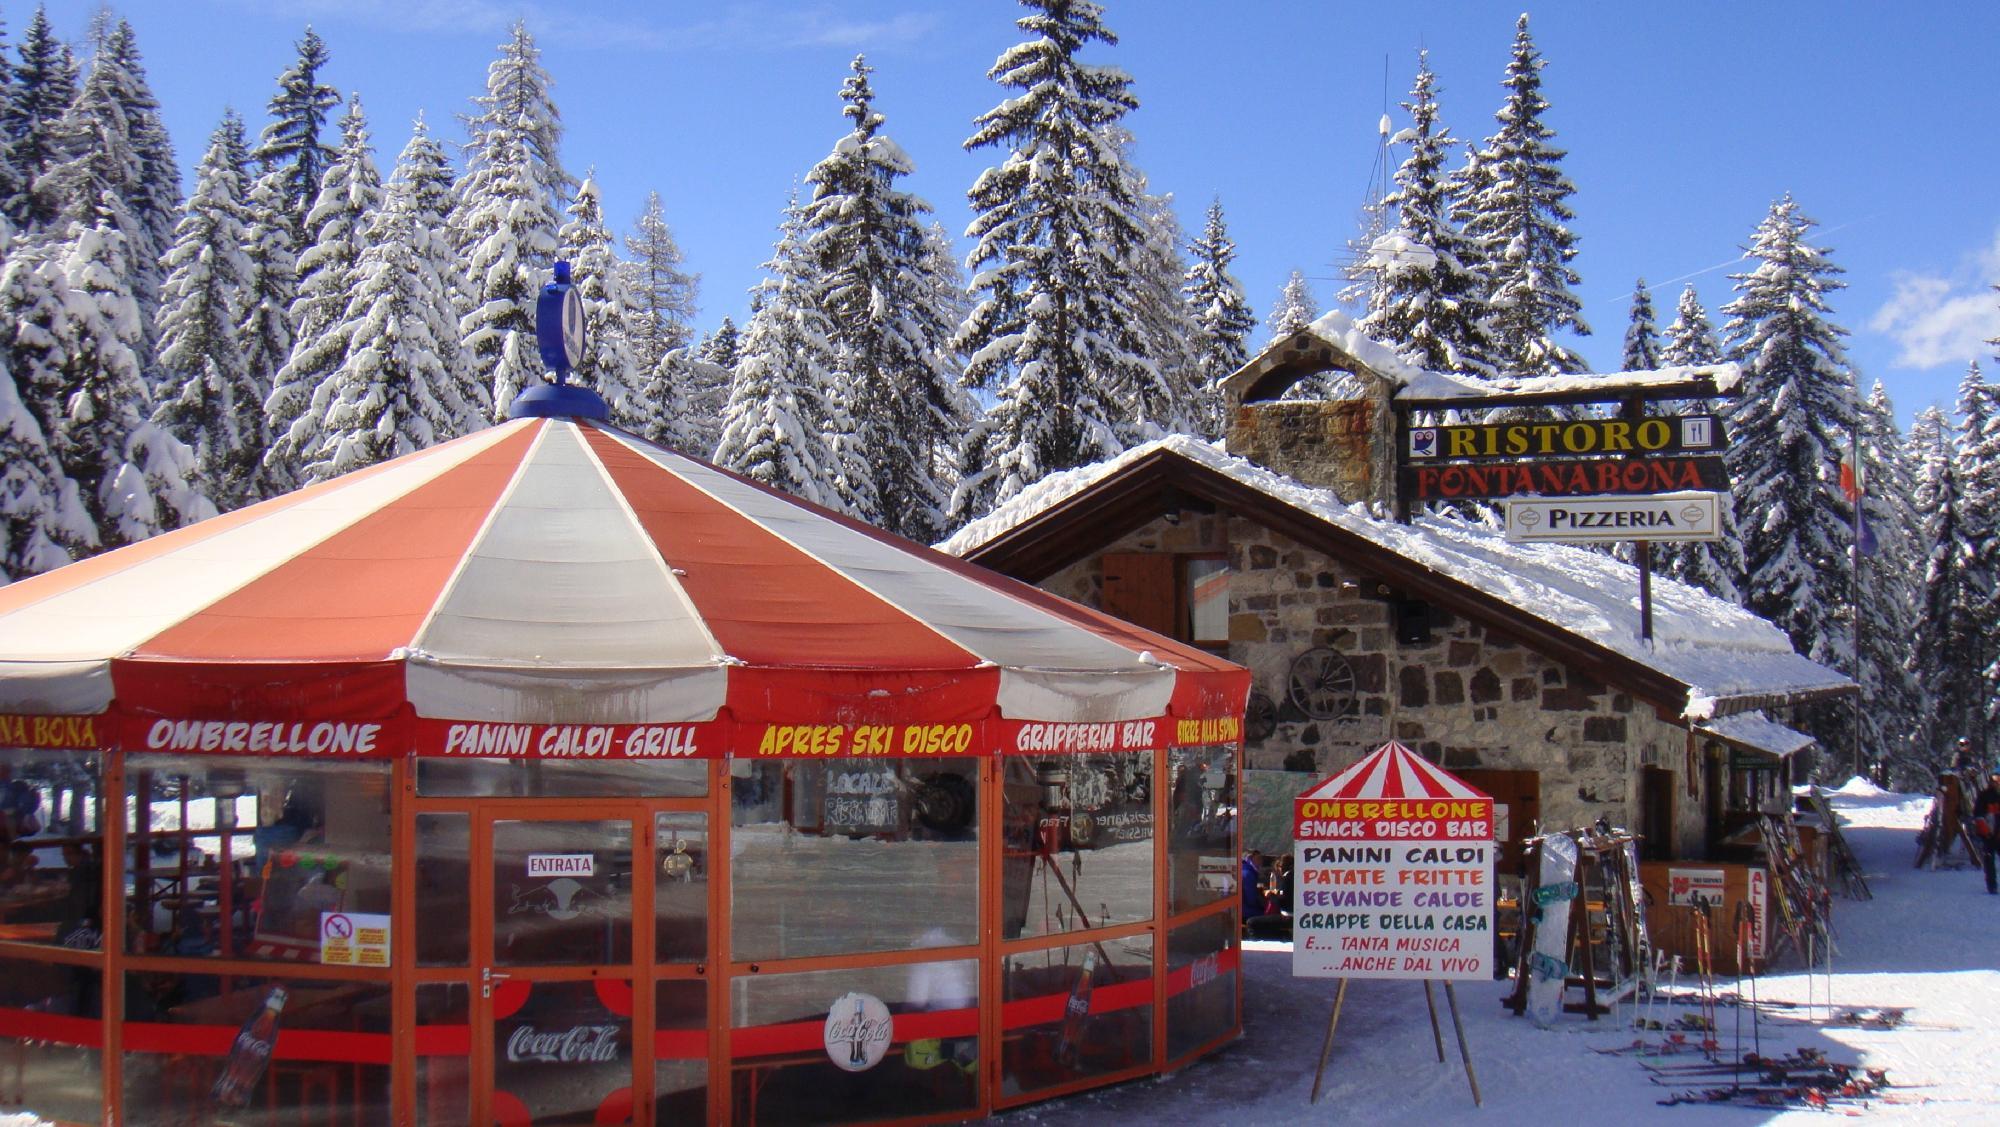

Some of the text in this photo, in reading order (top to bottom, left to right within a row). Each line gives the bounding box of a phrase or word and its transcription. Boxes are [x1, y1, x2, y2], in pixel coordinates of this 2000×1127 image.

[1448, 420, 1671, 457] RISTORO
[33, 716, 97, 747] BONA
[147, 719, 381, 754] OMBRELLONE
[445, 724, 531, 755] PANINI
[759, 724, 973, 754] APRES SKI DISCO
[1016, 720, 1156, 751] GRAPPERIA BAR
[1178, 719, 1200, 745] BIRRE
[1202, 719, 1218, 744] ALLA
[1301, 802, 1487, 819] OMBRELLONE
[1300, 821, 1488, 837] SNACK DISCO BAR
[1303, 847, 1484, 863] PANINI CALDI
[530, 857, 592, 873] ENTRATA
[1303, 869, 1484, 886] PATATE FRITTE
[1303, 891, 1484, 907] BEVANDE CALDE
[1299, 913, 1488, 931] GRAPPE DELLA CASA
[1341, 936, 1389, 951] TANTA
[1396, 938, 1461, 952] MUSICA
[1403, 957, 1433, 971] DAL
[1441, 958, 1480, 972] VIVO
